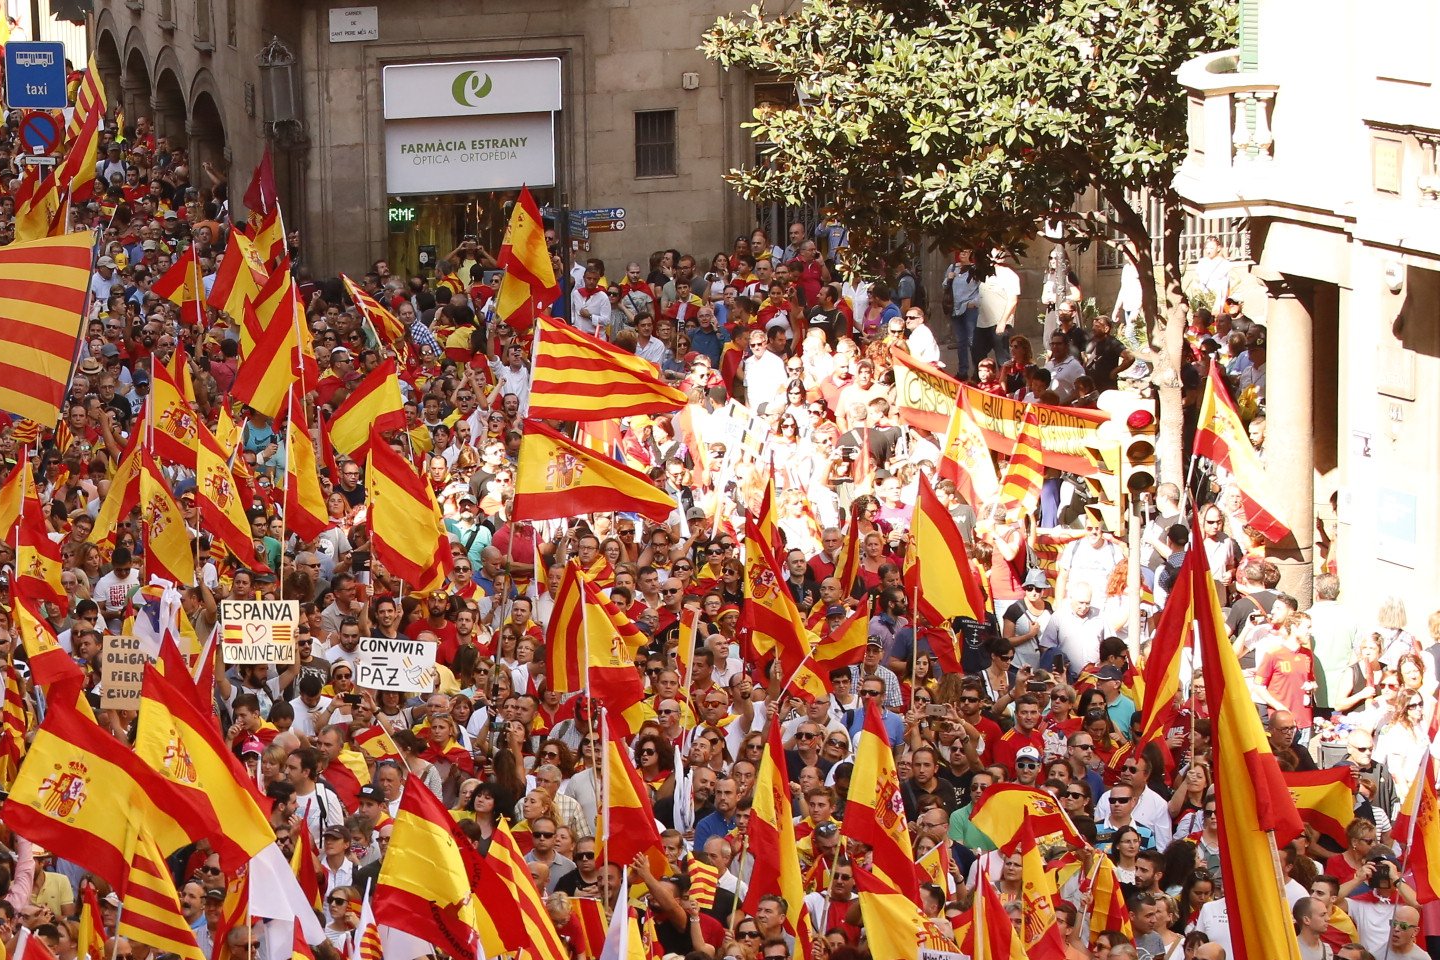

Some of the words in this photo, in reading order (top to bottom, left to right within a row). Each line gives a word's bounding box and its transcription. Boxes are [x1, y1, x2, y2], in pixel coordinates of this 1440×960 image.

[26, 83, 48, 95] taxi
[400, 139, 467, 154] FARMÀCIA
[471, 136, 528, 151] ESTRANY
[413, 153, 450, 166] ÒPTICA
[460, 151, 517, 164] ORTOPÈDIA
[222, 602, 293, 622] ESPANYA
[224, 642, 293, 662] CONVIVÈNCIA
[360, 639, 424, 656] CONVIVIR
[361, 666, 400, 687] PAZ
